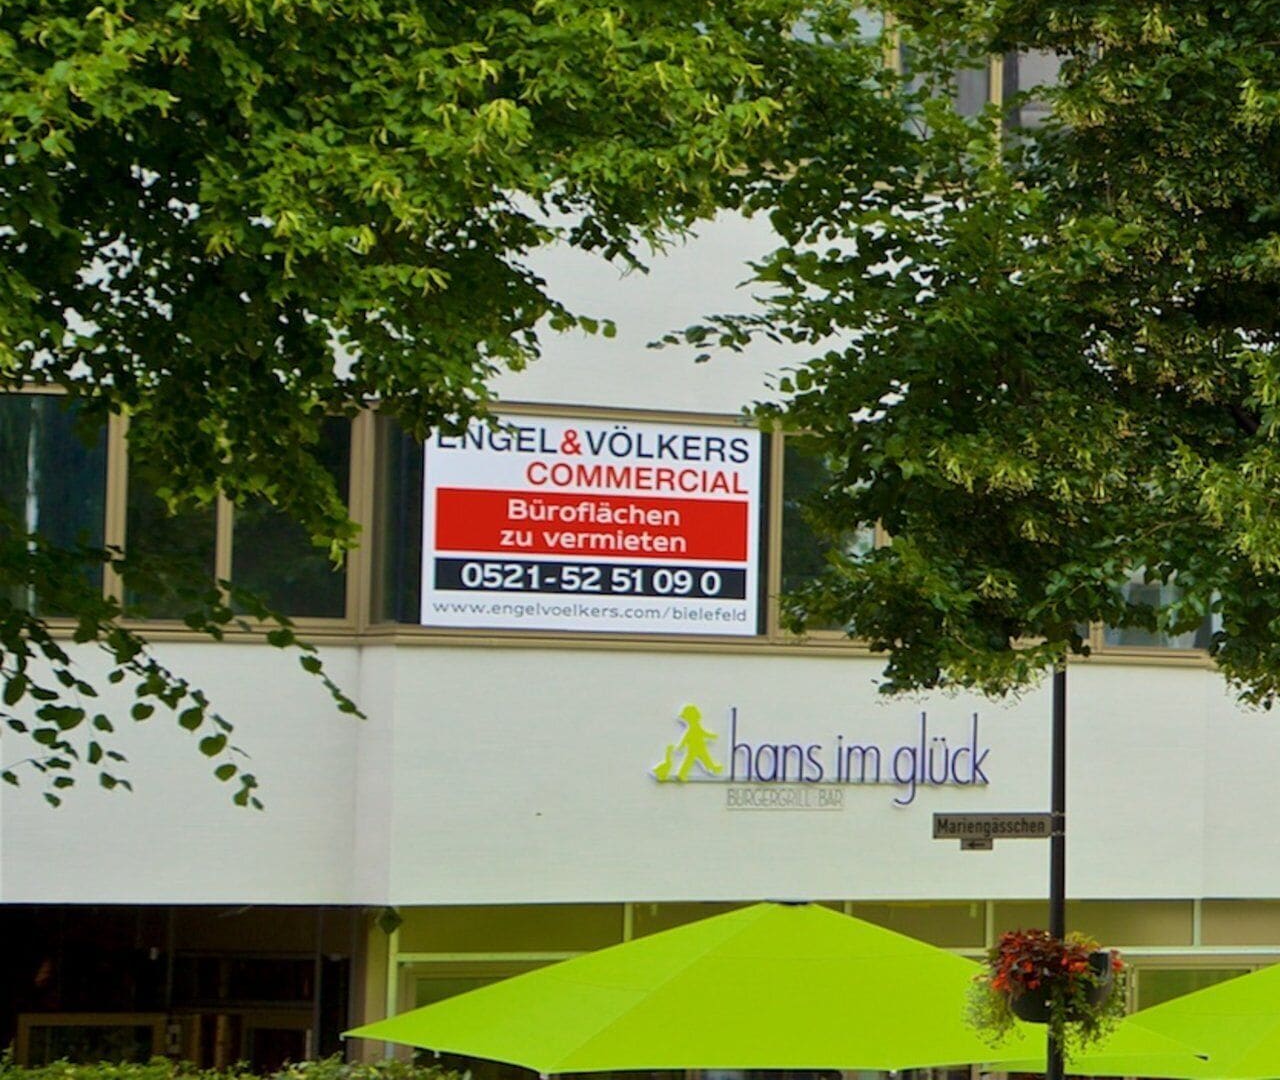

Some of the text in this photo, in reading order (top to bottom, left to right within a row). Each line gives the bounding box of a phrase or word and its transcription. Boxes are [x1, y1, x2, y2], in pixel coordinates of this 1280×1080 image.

[526, 461, 749, 494] COMMERCIAL
[507, 498, 681, 527] Büroflächen
[500, 529, 688, 553] zu vermieten
[611, 567, 643, 592] 51
[653, 569, 693, 594] 09
[701, 570, 722, 596] 0
[432, 600, 747, 622] www.engelvoelkers.com/bielefeld
[730, 707, 990, 805] hans im glück
[727, 788, 843, 807] BURGERGRILL BAR
[937, 817, 1045, 837] Mariengässchen
